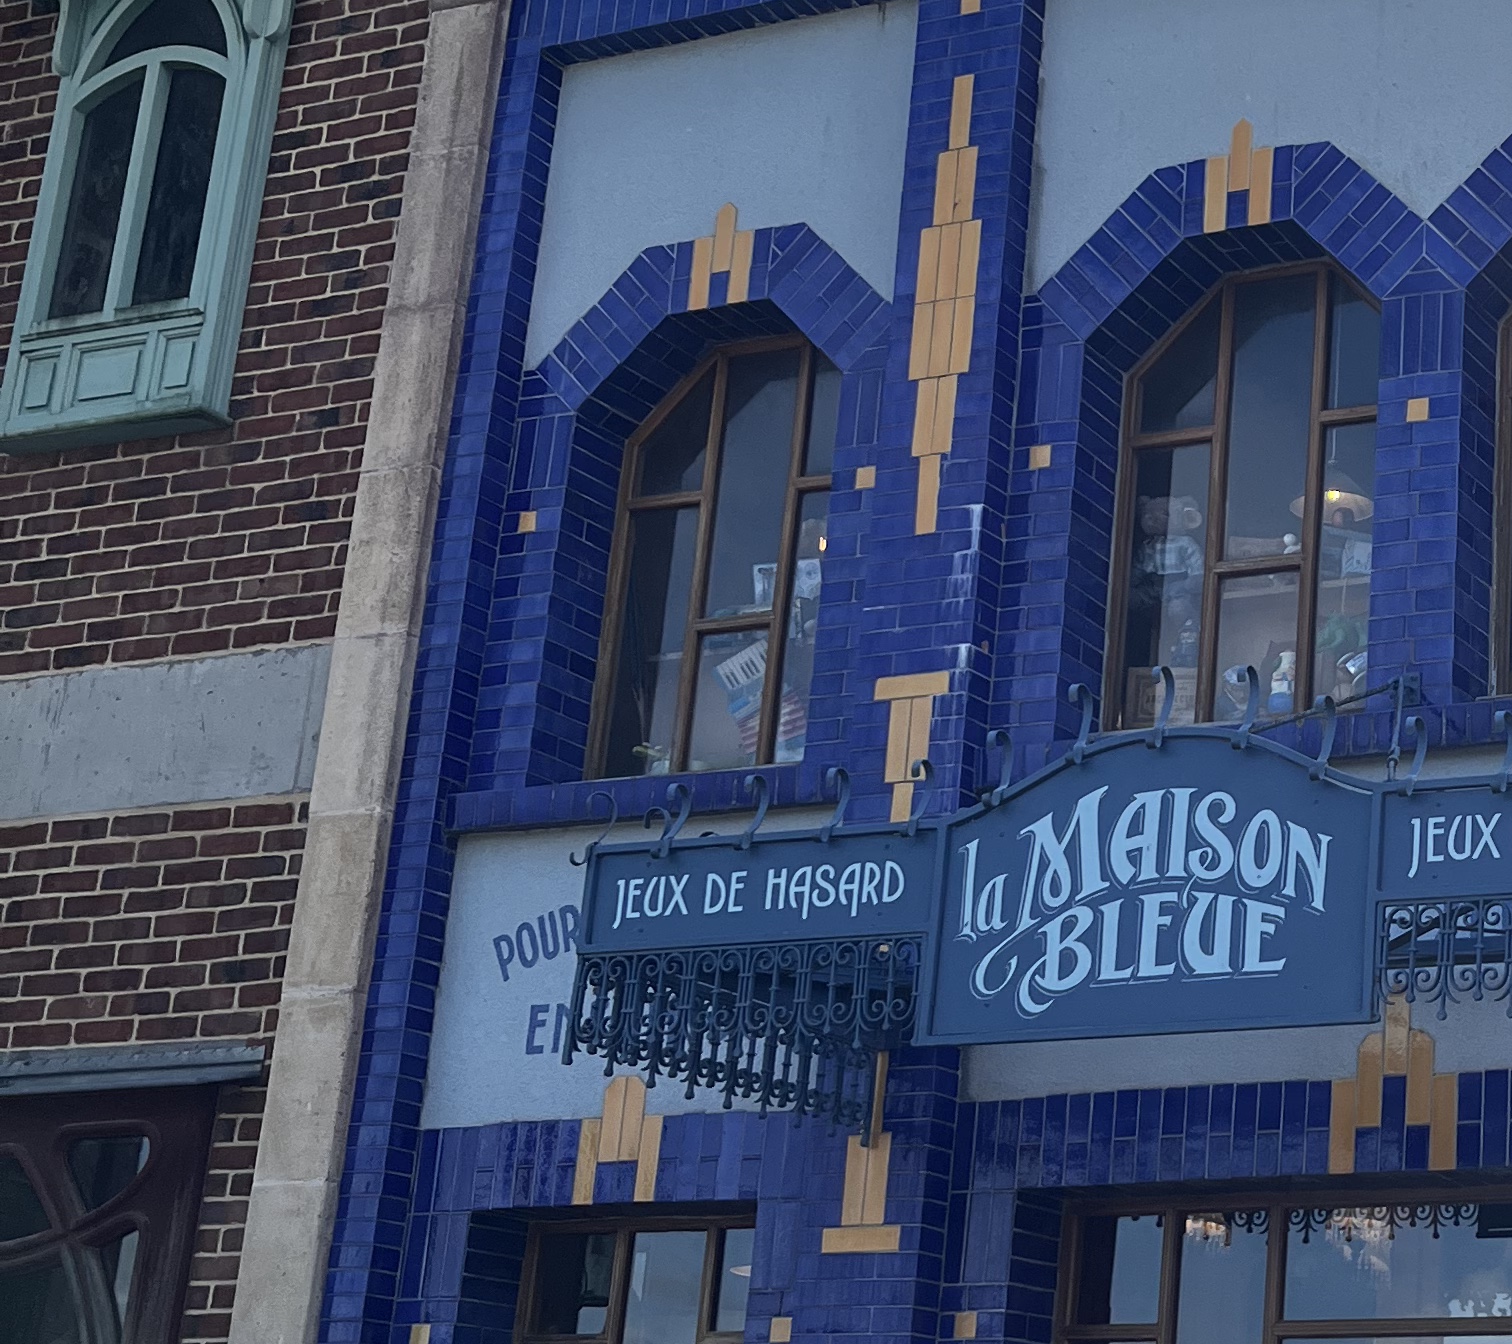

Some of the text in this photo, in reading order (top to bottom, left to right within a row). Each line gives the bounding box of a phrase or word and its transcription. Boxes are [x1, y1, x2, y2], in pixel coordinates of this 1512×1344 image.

[1407, 812, 1502, 879] JEUX
[612, 859, 905, 929] JEUX DE HASARD
[956, 785, 1335, 995] la MAISON
[492, 904, 580, 983] POUR
[1019, 890, 1288, 1014] BLEUE
